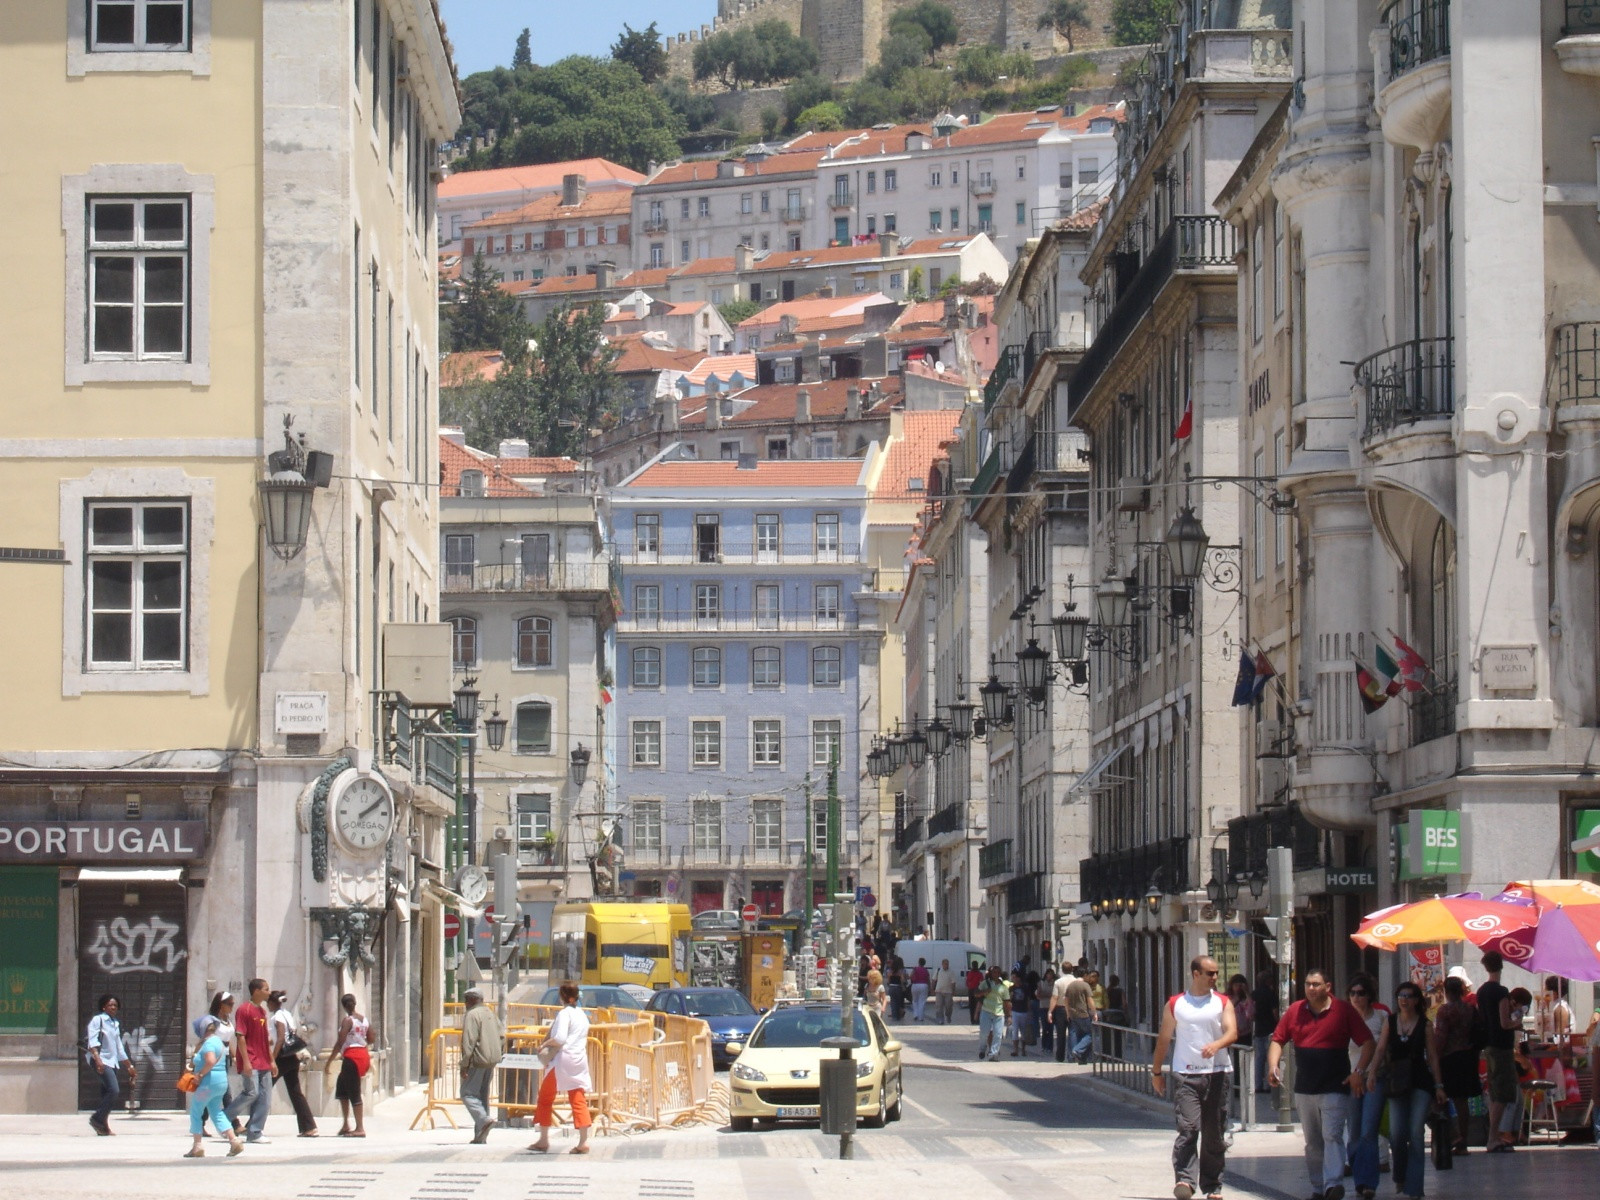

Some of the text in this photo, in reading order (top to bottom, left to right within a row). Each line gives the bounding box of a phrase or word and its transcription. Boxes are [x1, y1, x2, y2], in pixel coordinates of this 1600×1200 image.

[1501, 653, 1519, 661] RUA
[350, 820, 377, 830] OMEGA
[0, 827, 194, 854] PORTUGAL
[1425, 826, 1458, 848] BES
[1326, 873, 1376, 886] HOTEL
[259, 1018, 266, 1027] 7
